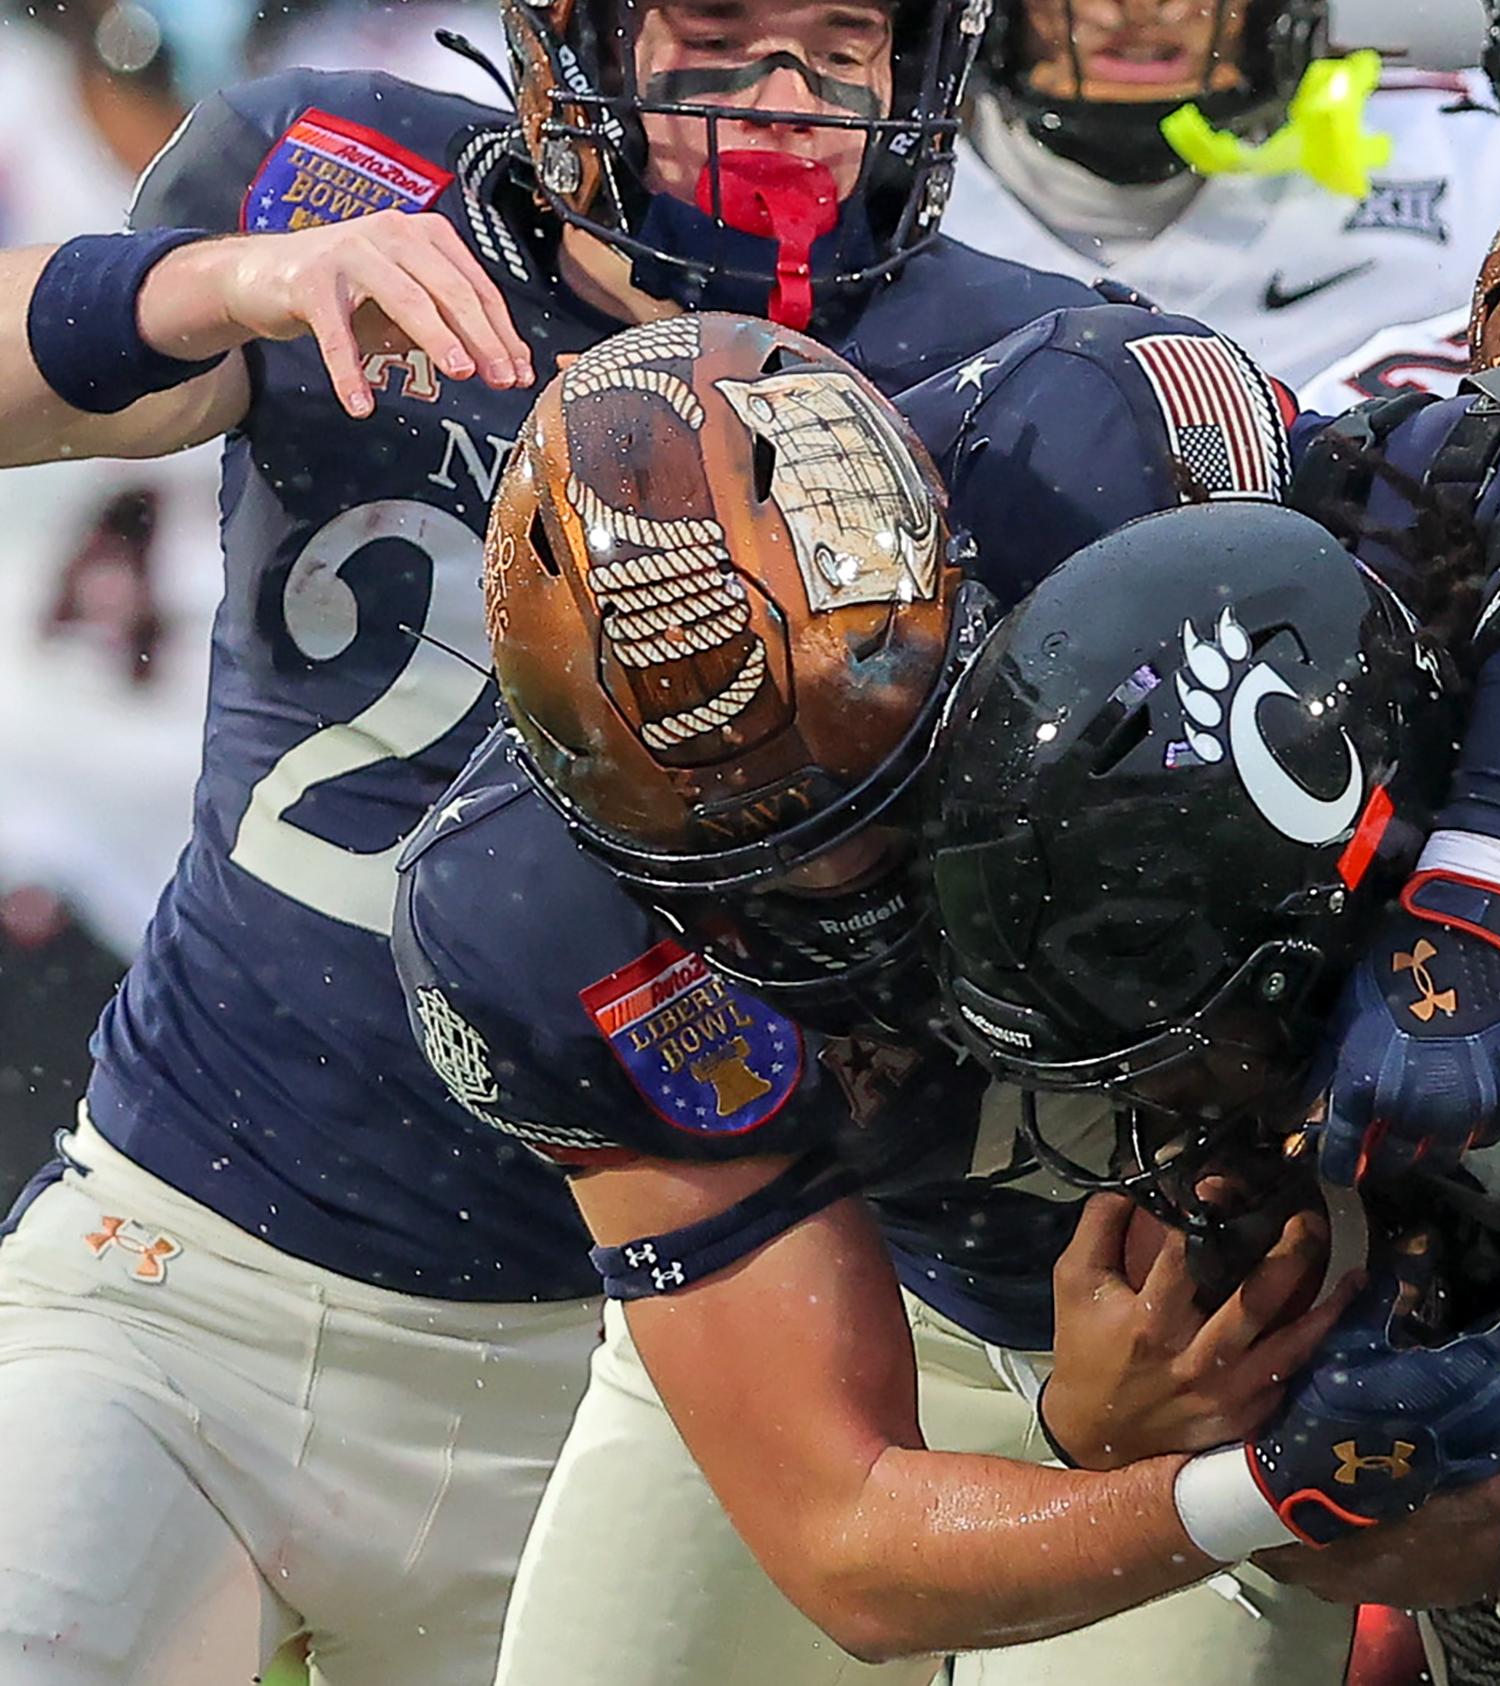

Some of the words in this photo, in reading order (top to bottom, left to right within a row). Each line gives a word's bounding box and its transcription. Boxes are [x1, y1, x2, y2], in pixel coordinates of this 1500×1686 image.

[287, 147, 410, 208] LIBERTY
[818, 895, 906, 935] Riddell
[627, 977, 730, 1053] LIBERT
[658, 999, 753, 1073] BOWL
